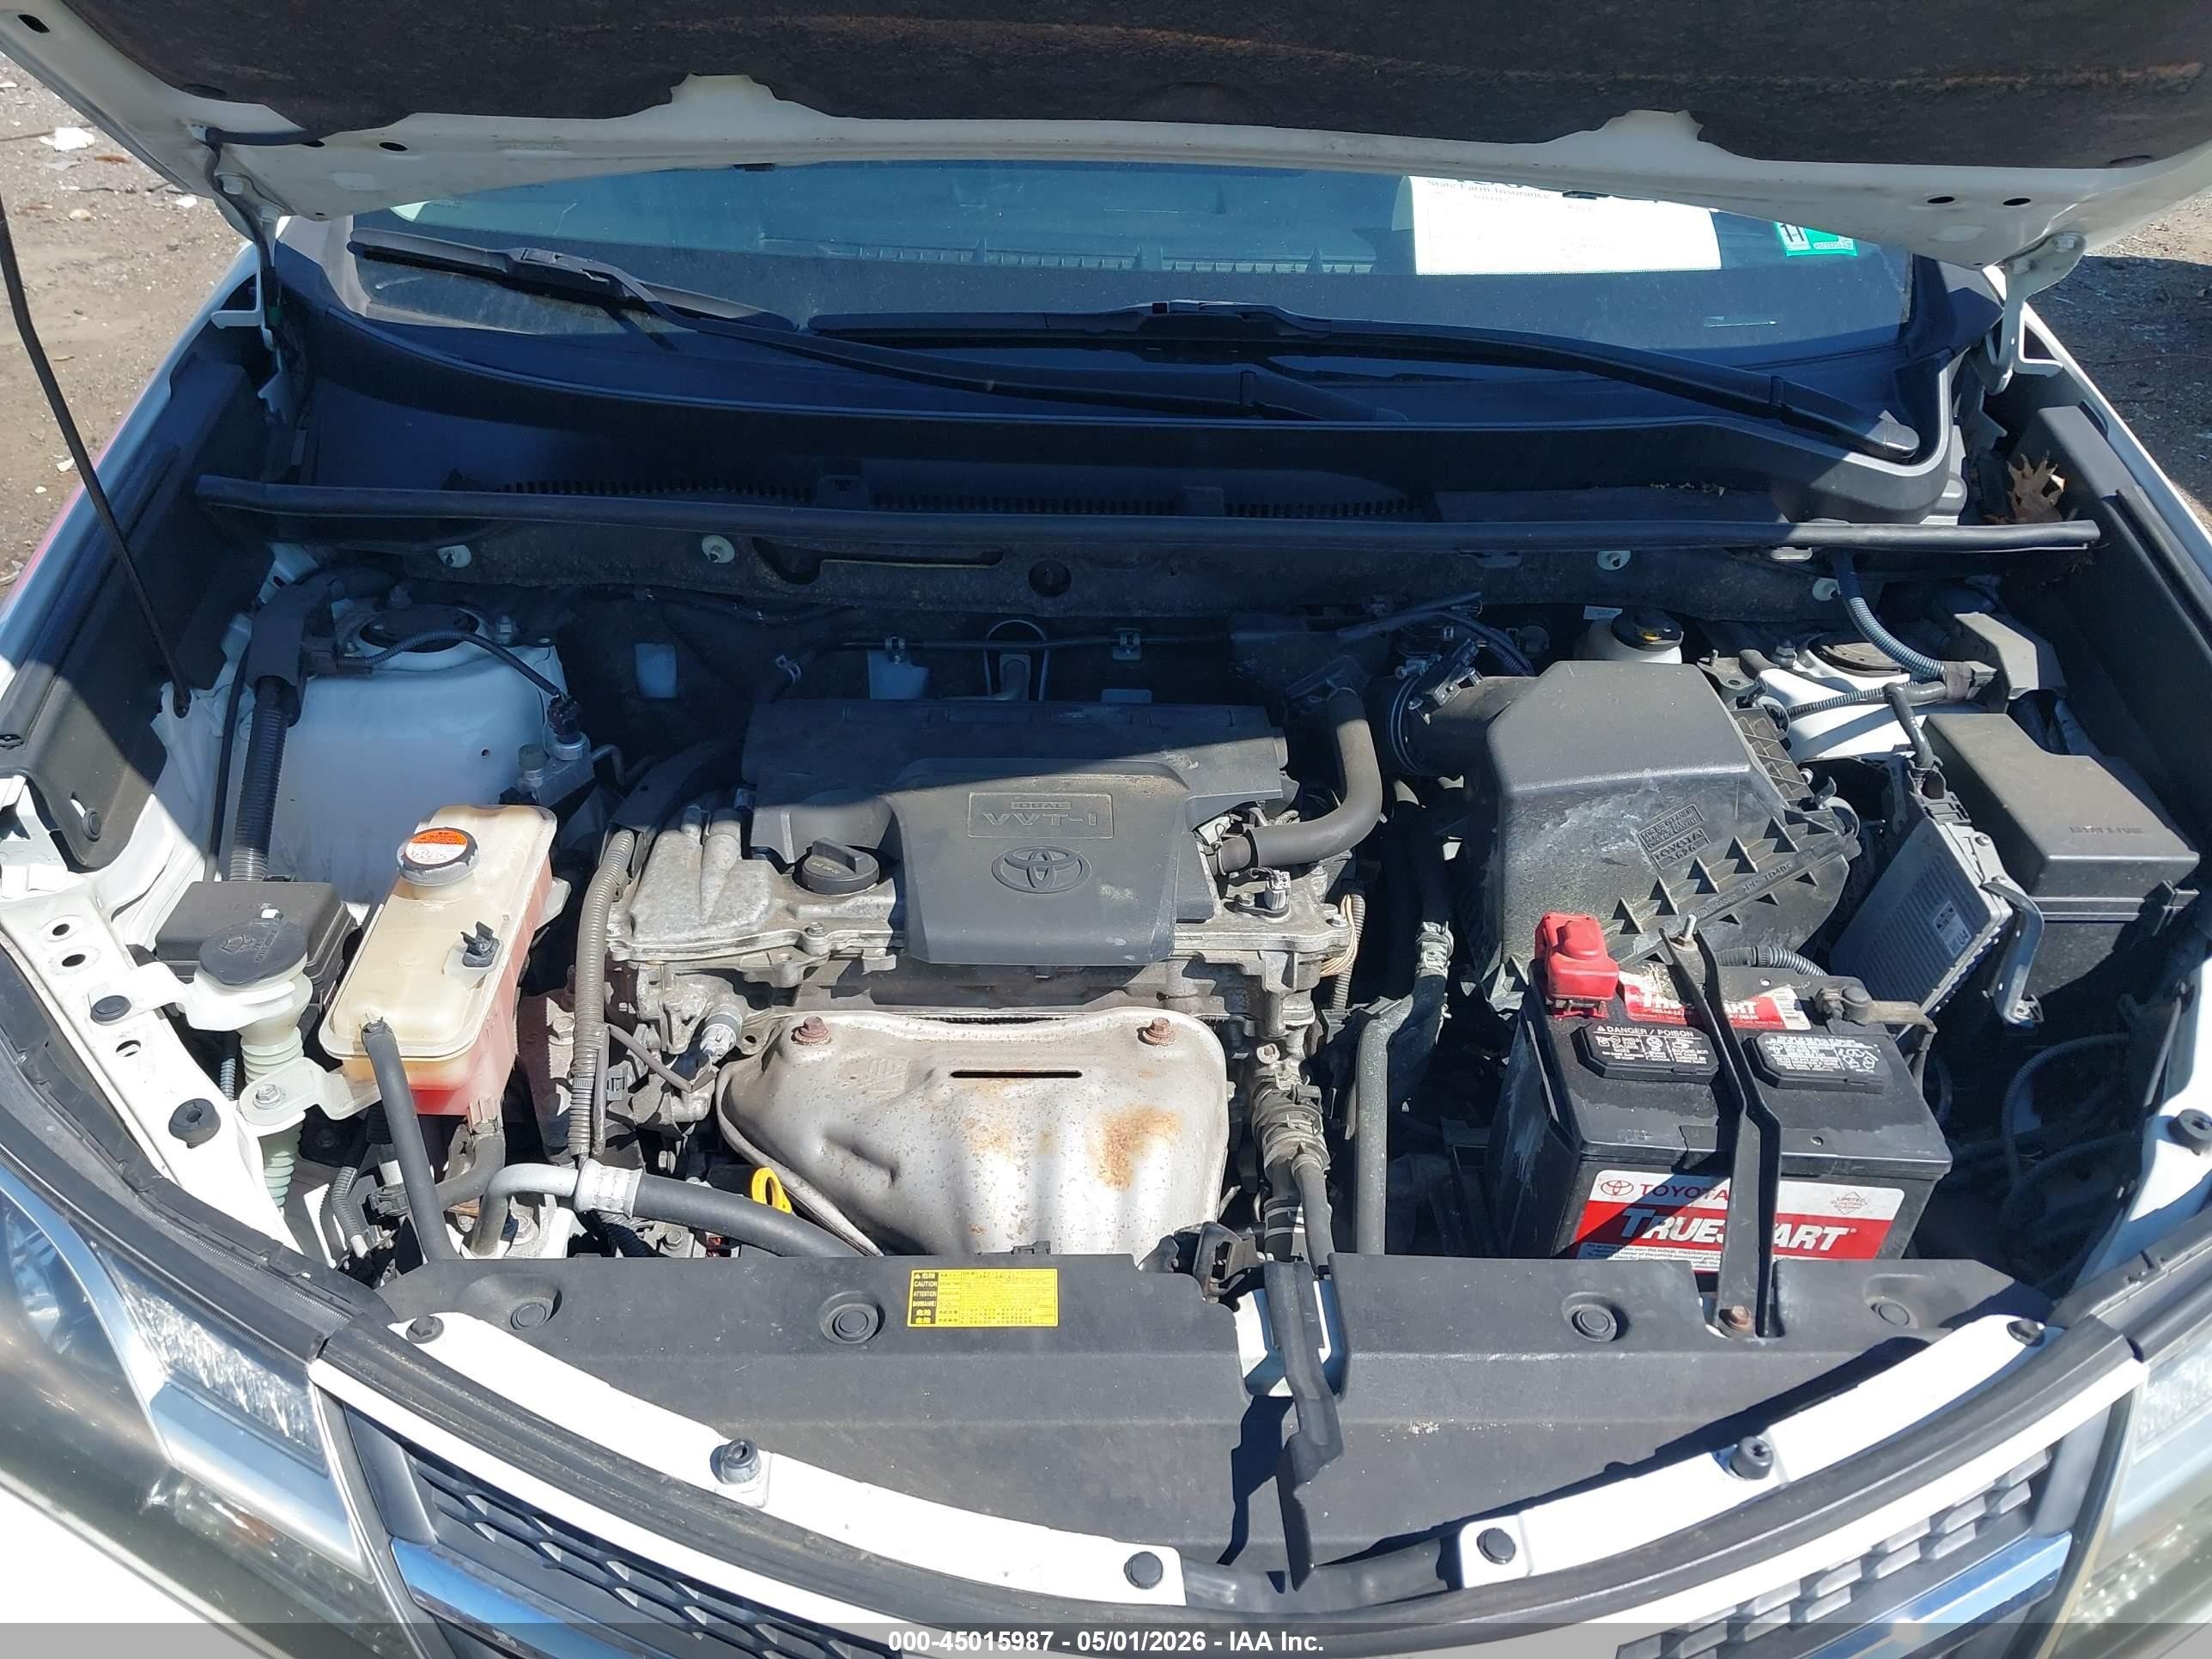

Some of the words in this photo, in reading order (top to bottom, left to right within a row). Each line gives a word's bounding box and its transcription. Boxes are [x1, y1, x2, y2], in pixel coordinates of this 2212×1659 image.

[1653, 830, 1704, 860] TOYOTA
[1606, 1026, 1648, 1035] DANGER
[1657, 1029, 1694, 1037] POISON
[1640, 1183, 1728, 1200] TOYOTA
